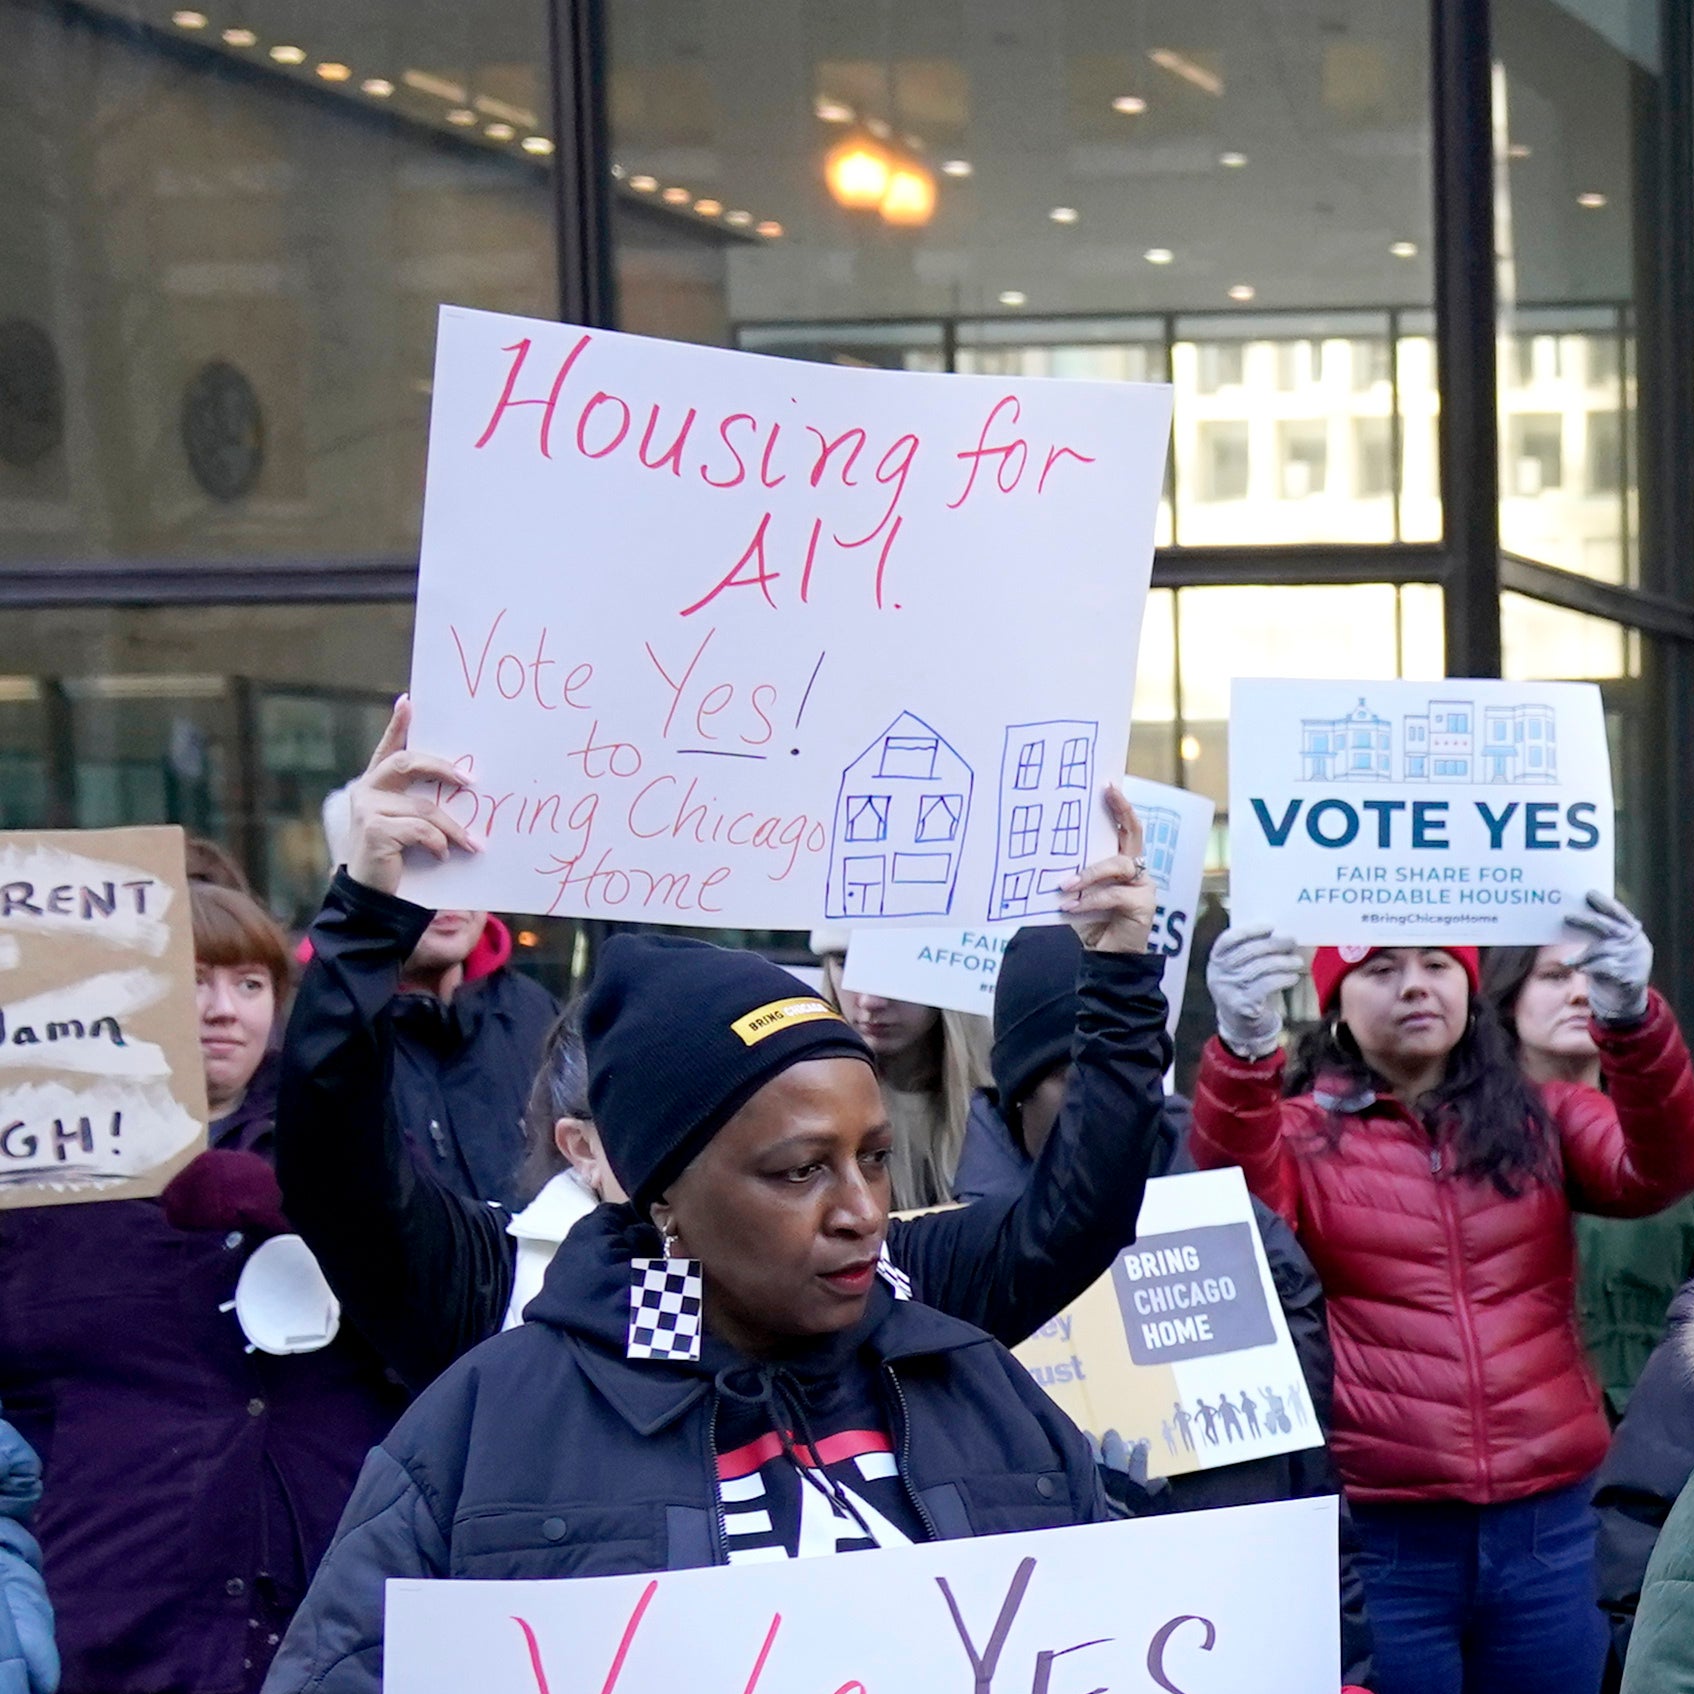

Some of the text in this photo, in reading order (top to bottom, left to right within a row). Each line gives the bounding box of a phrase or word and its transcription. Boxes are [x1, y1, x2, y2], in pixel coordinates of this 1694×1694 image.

[475, 333, 1097, 547] Housing for
[451, 608, 825, 755] Vote Yes!
[568, 720, 641, 777] to
[628, 775, 826, 881] Chicago
[1250, 797, 1600, 851] VOTE YES
[535, 848, 731, 914] Home
[1337, 866, 1523, 883] FAIR SHARE FOR
[0, 880, 154, 920] RENT
[1298, 888, 1562, 905] AFFORDABLE HOUSING
[1361, 913, 1499, 925] #BringChicagoHome
[918, 947, 999, 973] AFFOR
[749, 1011, 784, 1031] BRING
[1124, 1246, 1200, 1282] BRING
[1133, 1276, 1236, 1315] CHICAGO
[1141, 1314, 1213, 1350] HOME
